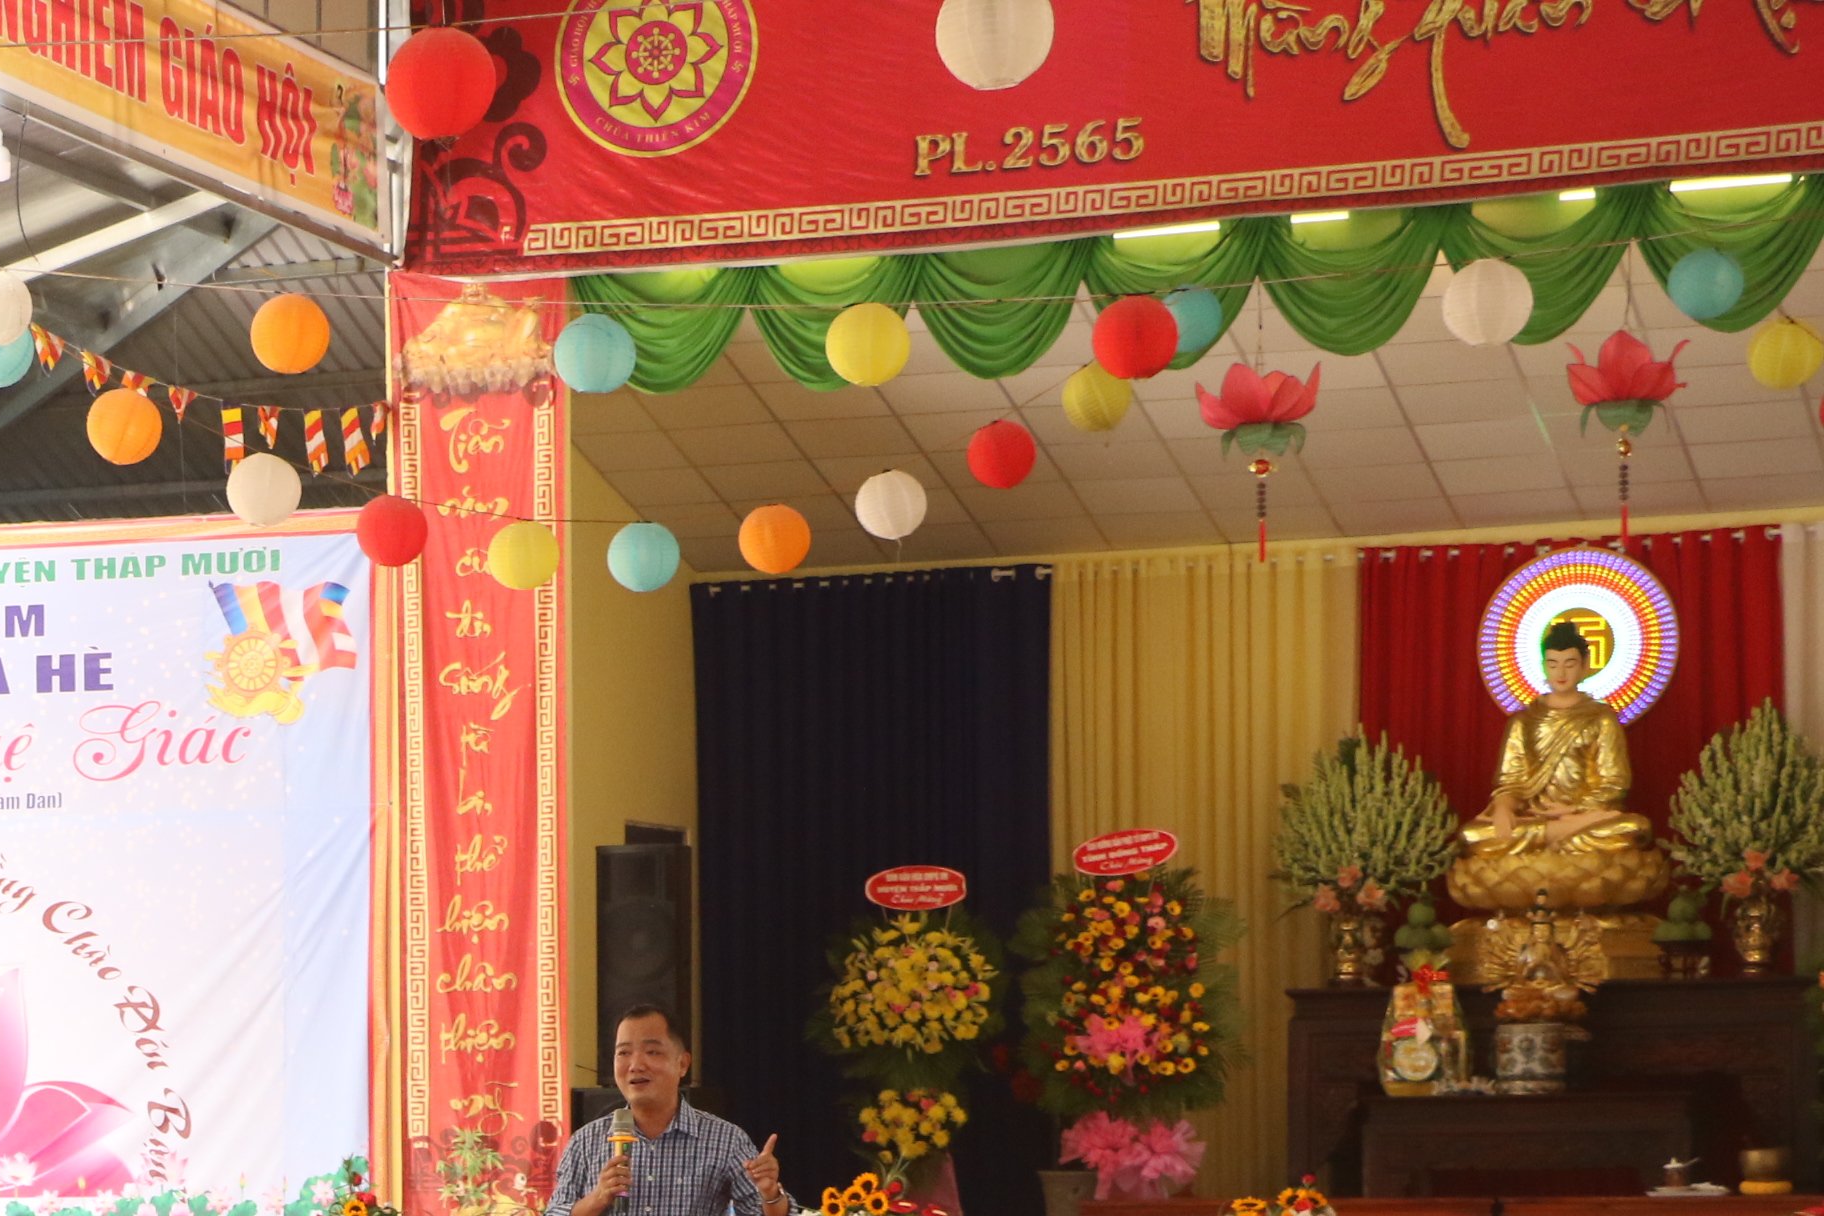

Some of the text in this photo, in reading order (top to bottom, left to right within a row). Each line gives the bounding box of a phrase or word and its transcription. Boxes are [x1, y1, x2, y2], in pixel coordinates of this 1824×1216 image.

[159, 16, 246, 147] GIÁO
[256, 62, 318, 187] HỘI
[684, 111, 712, 135] KIM
[913, 117, 1145, 178] PL.2565
[437, 485, 509, 522] năm
[35, 646, 114, 694] HÈ
[73, 700, 252, 783] Giác
[454, 834, 508, 886] thể
[42, 900, 123, 980] Chào
[436, 894, 510, 944] hiện
[436, 953, 518, 994] chân
[440, 1012, 516, 1064] thiện
